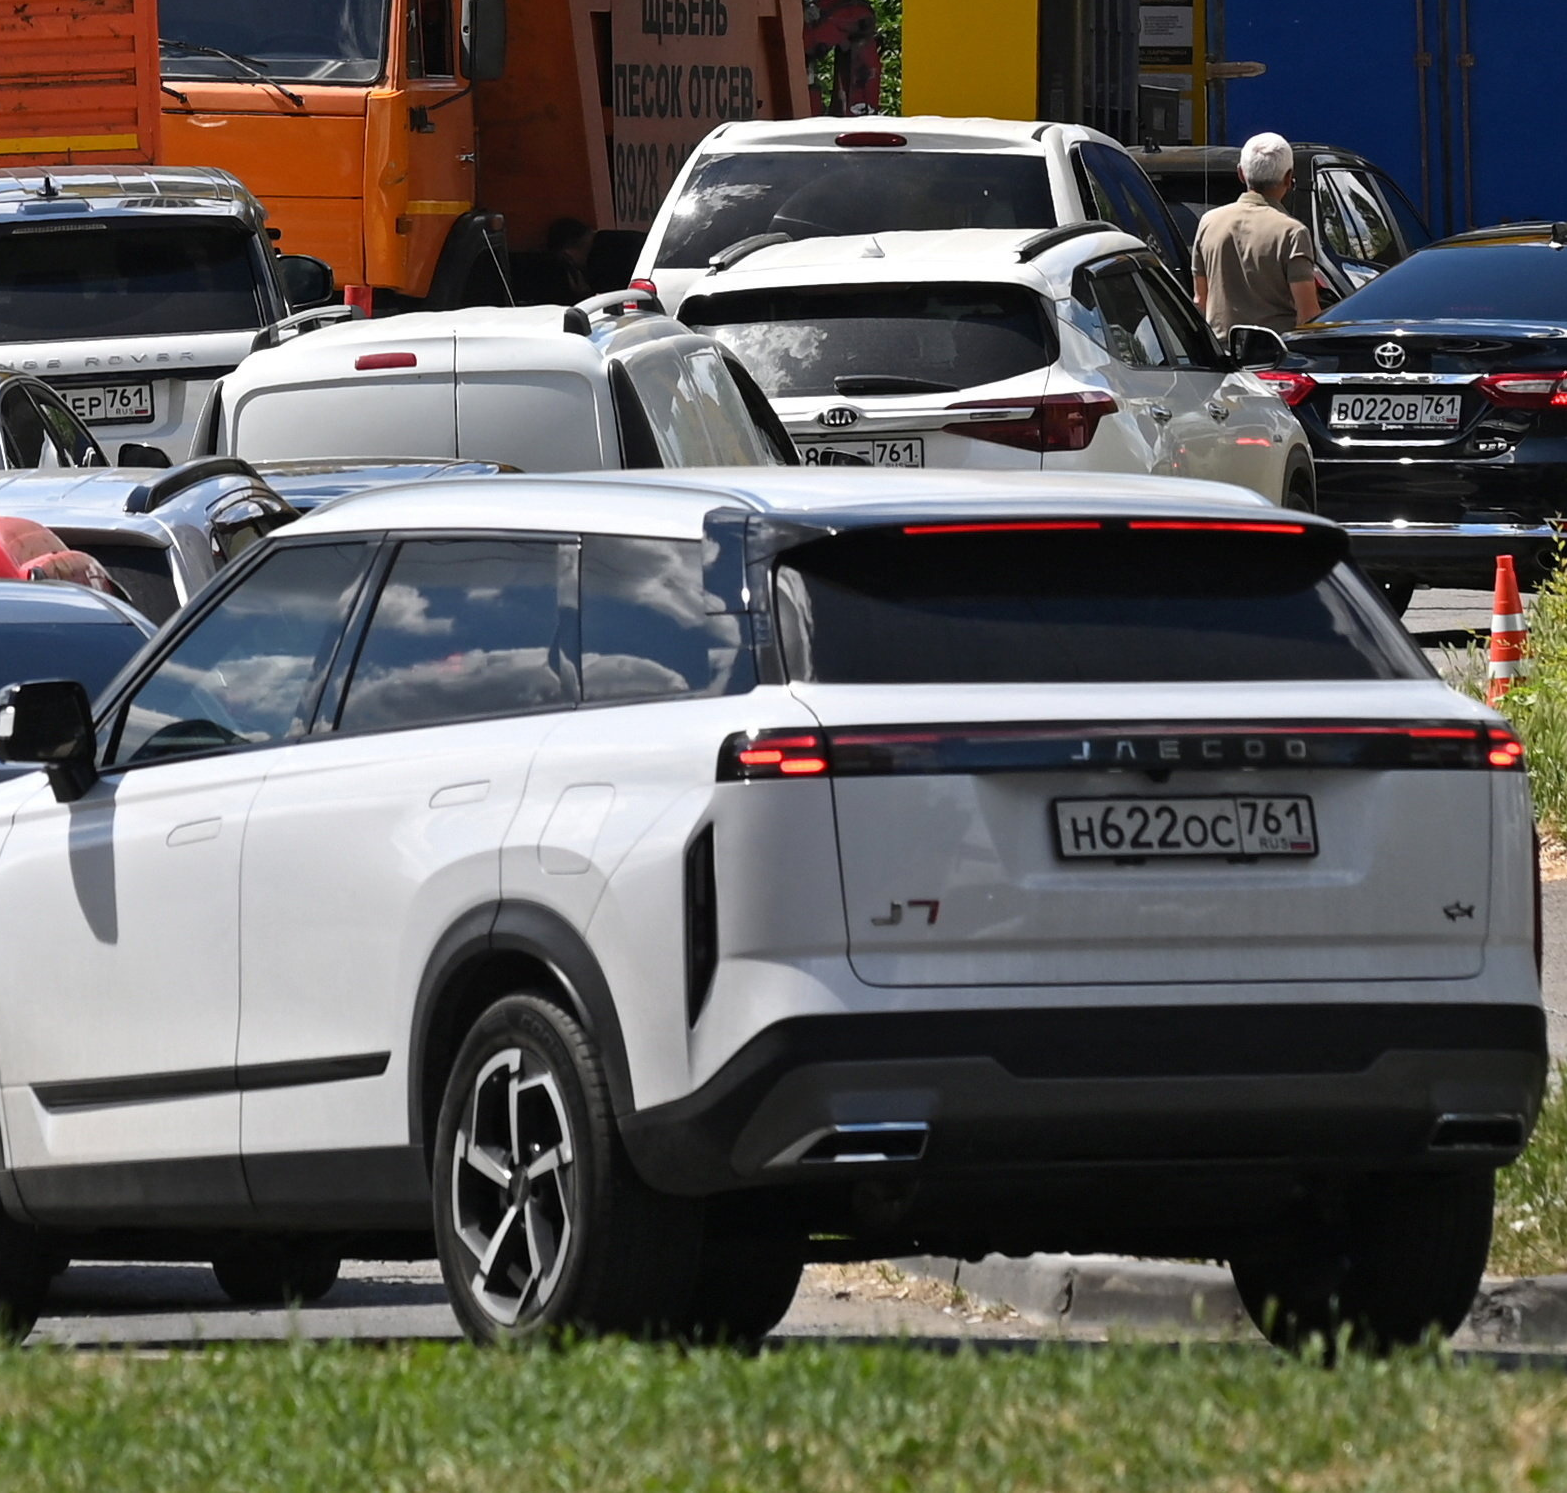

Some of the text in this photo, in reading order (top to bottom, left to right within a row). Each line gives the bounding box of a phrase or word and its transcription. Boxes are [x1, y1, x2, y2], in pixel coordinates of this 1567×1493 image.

[614, 63, 754, 121] ПЕСОК ОТСЕВ
[616, 142, 659, 223] 8928
[84, 351, 195, 367] ROVER
[105, 387, 145, 408] 761
[115, 407, 134, 416] RUS
[823, 410, 853, 425] KIA
[1337, 396, 1456, 422] В022ОВ 761
[876, 442, 914, 463] 761
[1070, 739, 1308, 761] JAECOO
[1240, 801, 1303, 836] 761
[1259, 836, 1290, 851] RUS
[870, 898, 940, 927] J7
